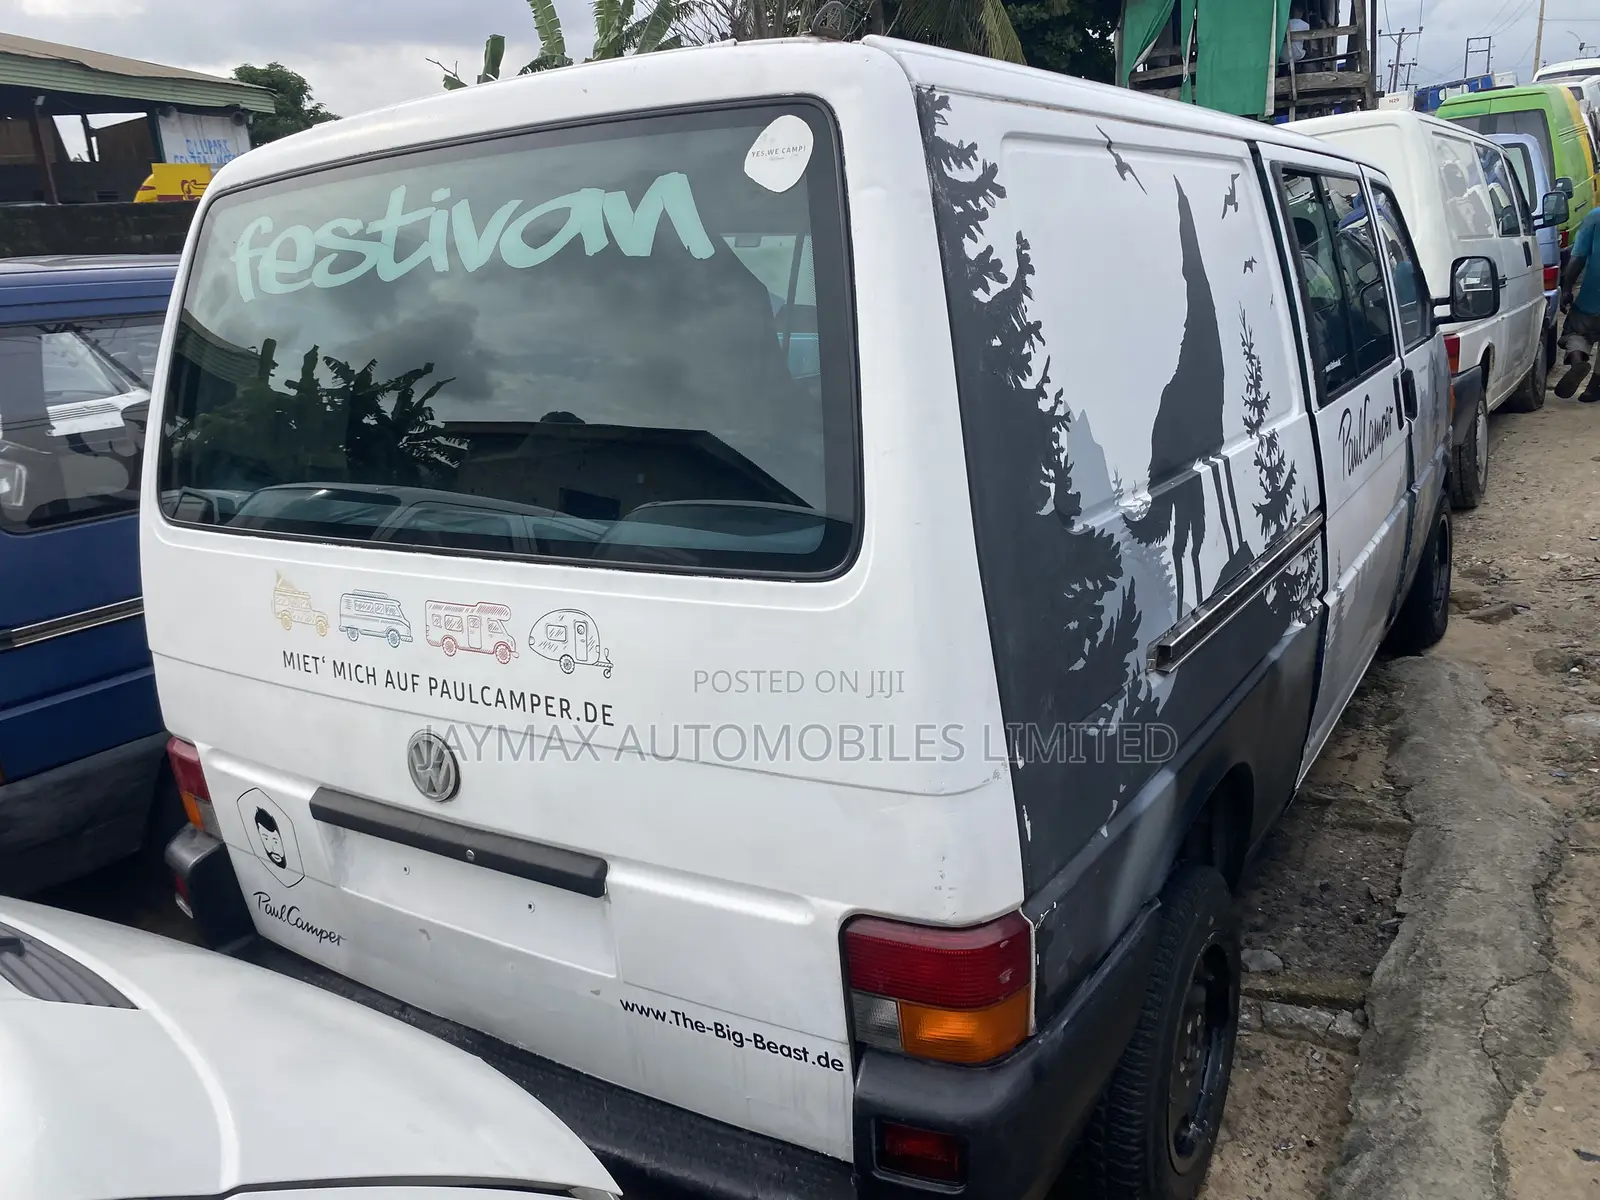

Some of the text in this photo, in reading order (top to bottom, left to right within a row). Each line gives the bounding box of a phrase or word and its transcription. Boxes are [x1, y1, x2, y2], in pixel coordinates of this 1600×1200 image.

[768, 148, 780, 156] WE
[230, 171, 715, 302] festivan
[1338, 394, 1394, 481] PaulCamper
[333, 660, 377, 686] MICH
[385, 670, 420, 692] AUF
[428, 677, 615, 727] PAULCAMPER.DE
[252, 891, 347, 946] PaulCamper
[620, 999, 845, 1072] www.The-Big-Beast.de
